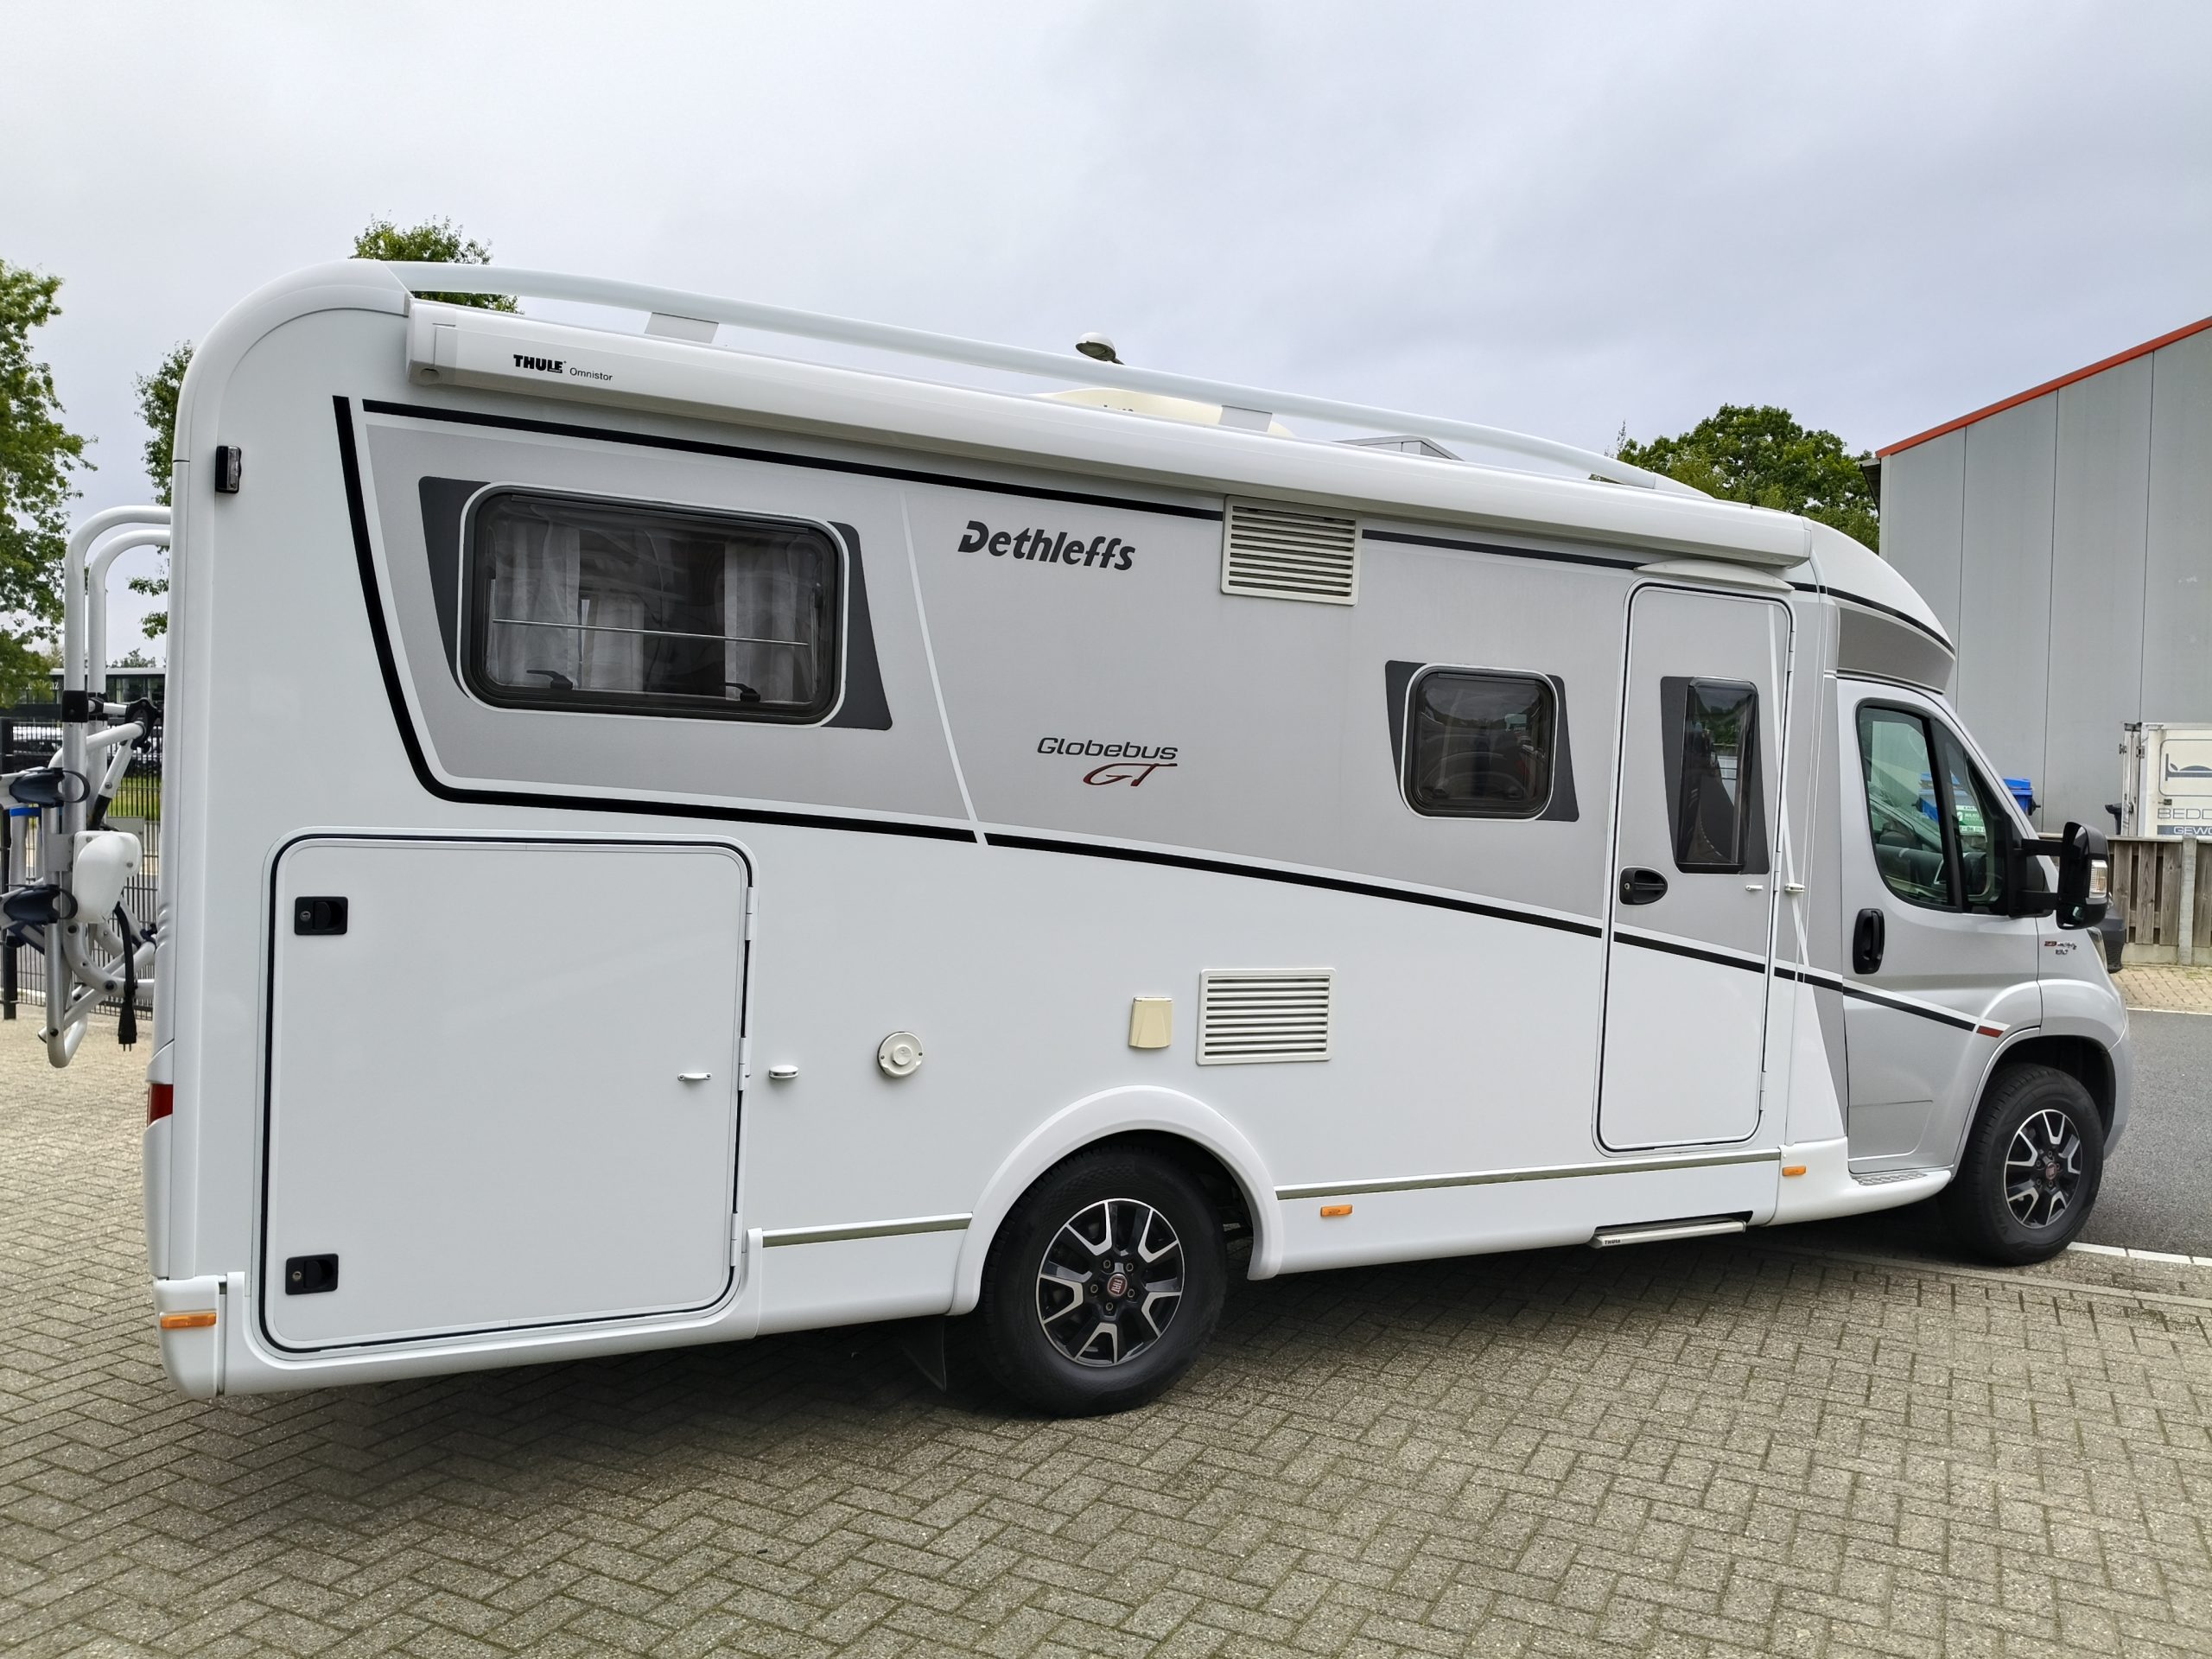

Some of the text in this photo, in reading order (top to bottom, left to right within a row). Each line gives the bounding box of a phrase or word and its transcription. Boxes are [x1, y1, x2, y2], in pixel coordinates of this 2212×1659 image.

[513, 354, 613, 381] THULE Omnistor
[957, 520, 1135, 571] Dethleffs
[1037, 737, 1178, 760] Globebus
[1083, 763, 1178, 787] GT
[1111, 1278, 1123, 1294] FIAT
